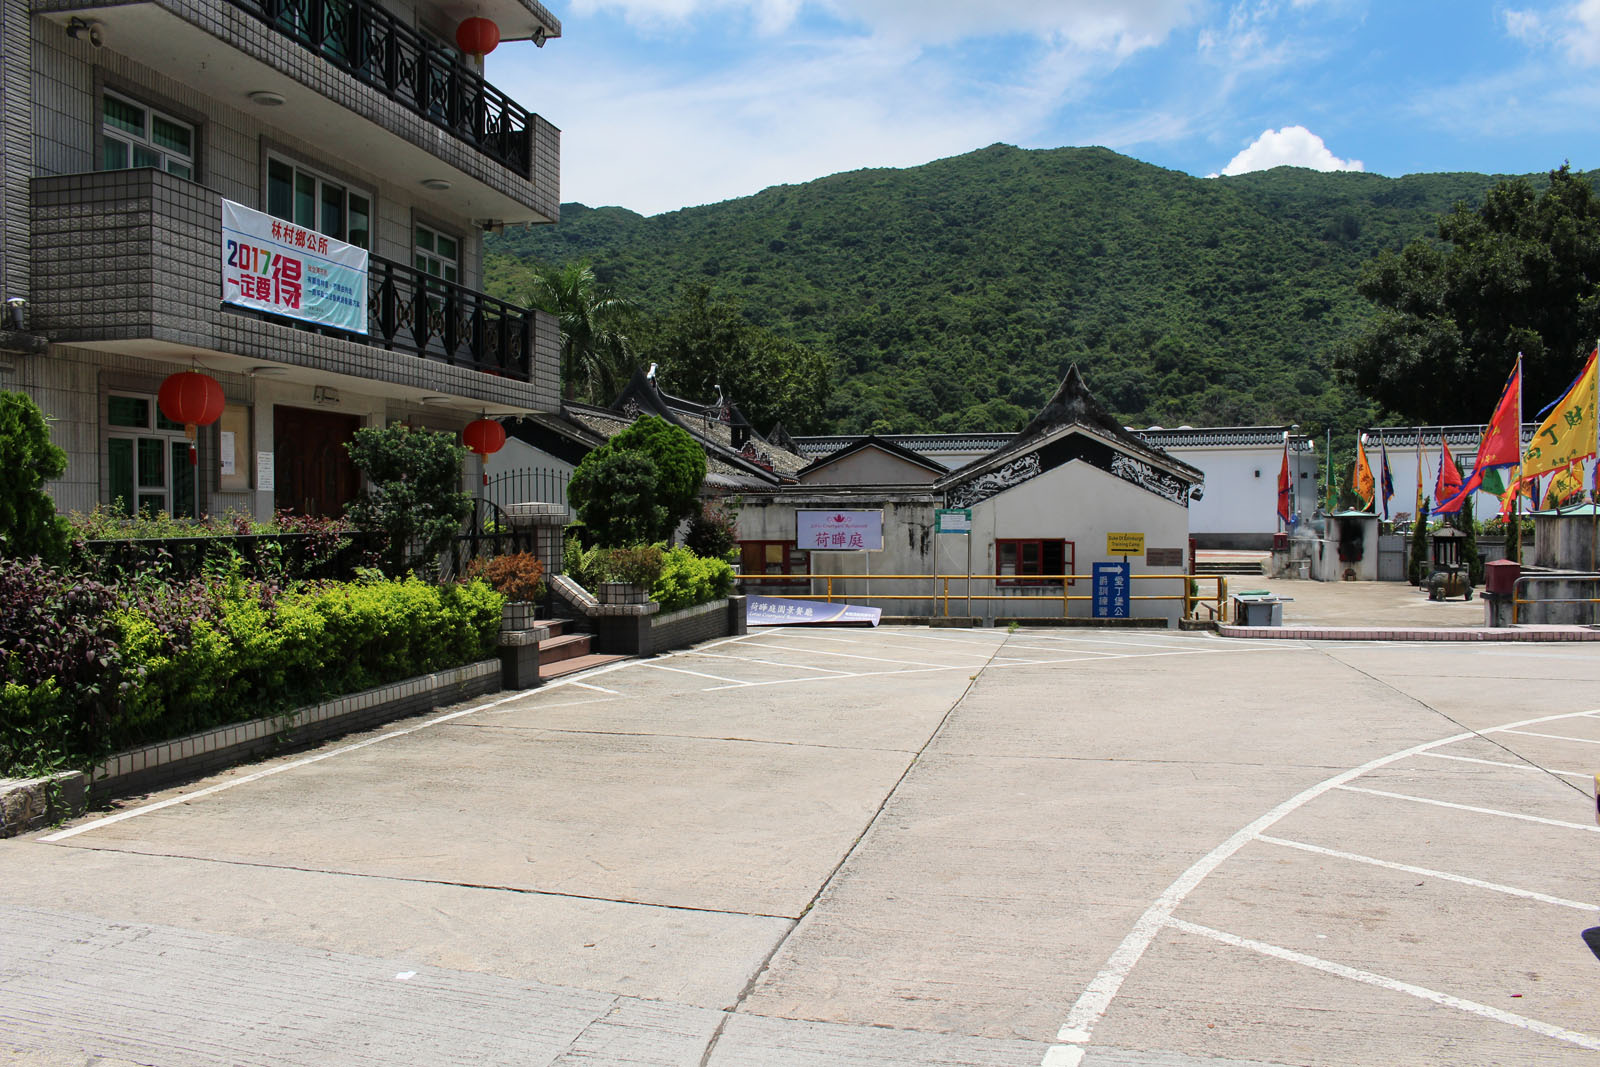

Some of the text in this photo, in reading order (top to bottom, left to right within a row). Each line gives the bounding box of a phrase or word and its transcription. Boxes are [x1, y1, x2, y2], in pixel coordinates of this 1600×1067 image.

[228, 239, 271, 275] 2017
[271, 220, 329, 256] 林村鄉公所
[228, 273, 271, 302] 一定要
[272, 254, 303, 309] 得
[1114, 575, 1125, 616] 愛丁堡公
